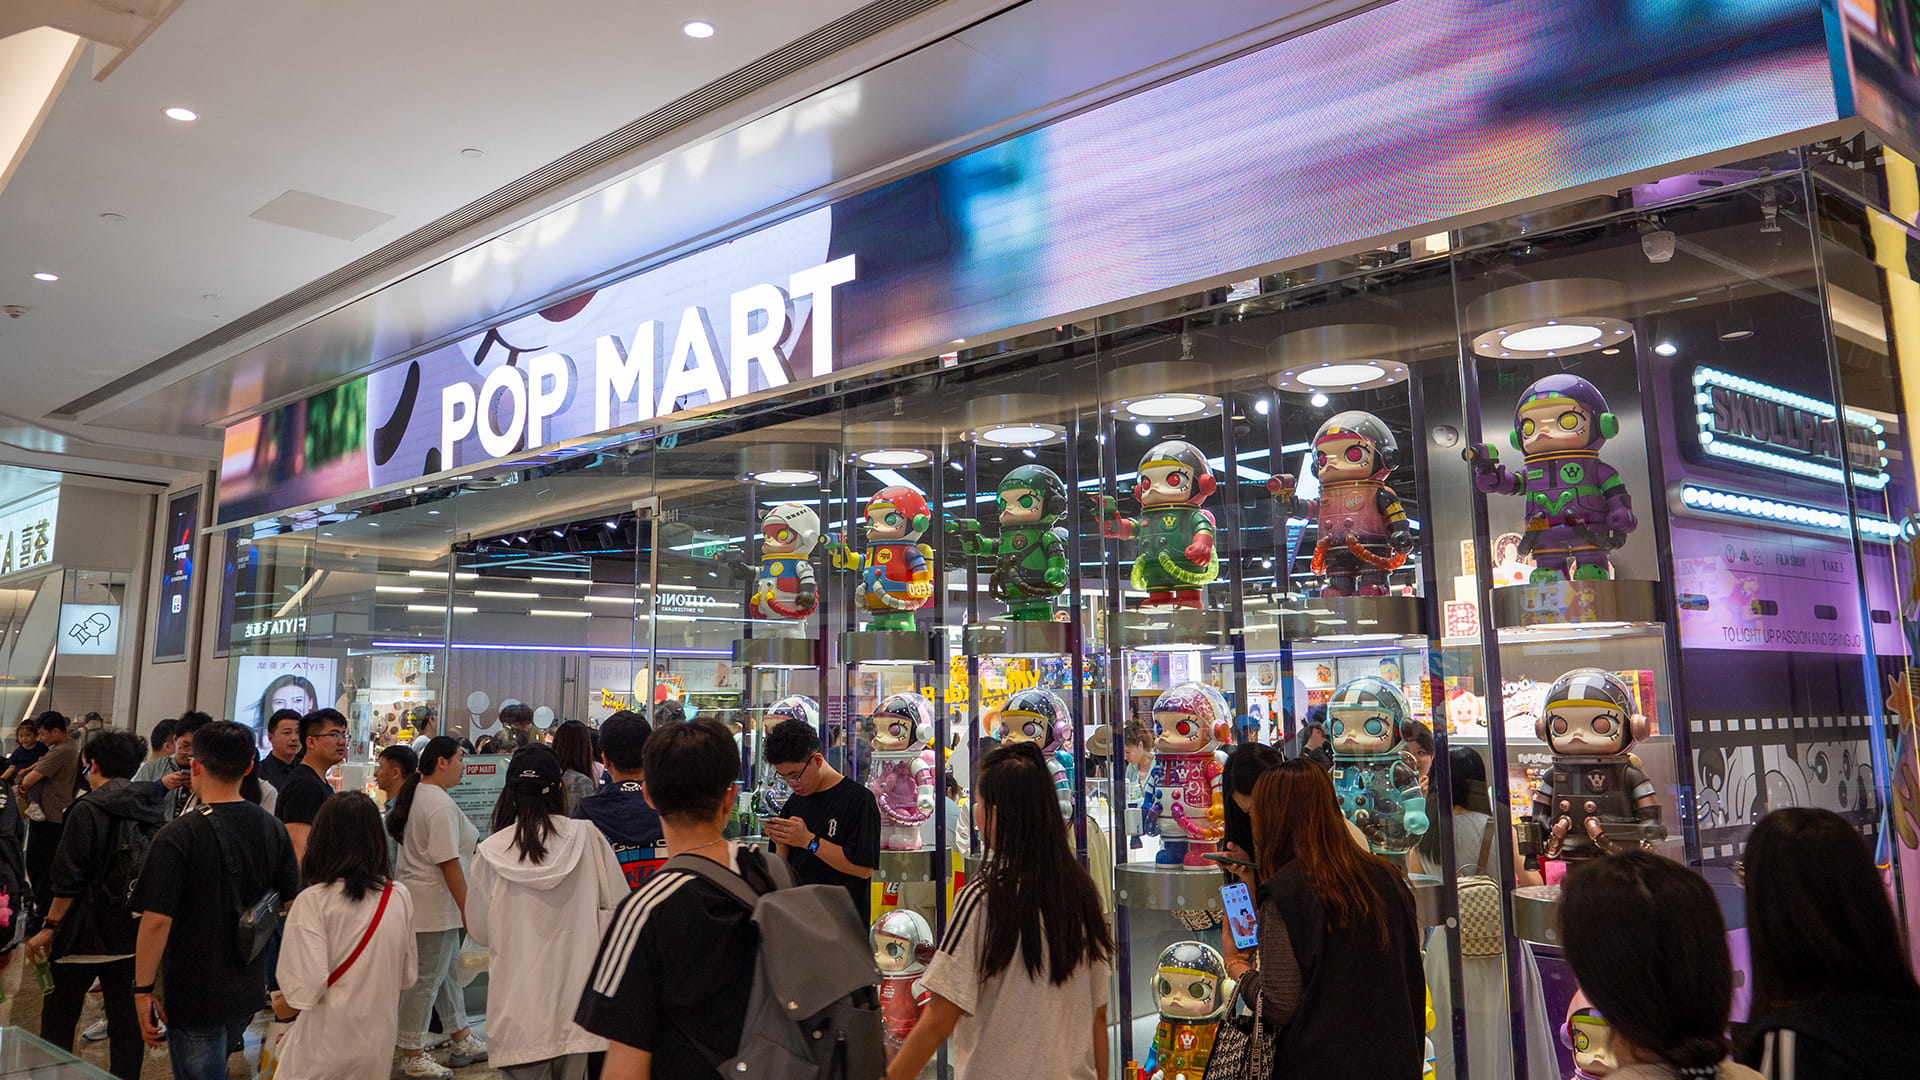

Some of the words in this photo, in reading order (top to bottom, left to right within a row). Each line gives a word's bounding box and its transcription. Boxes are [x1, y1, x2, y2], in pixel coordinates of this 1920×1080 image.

[441, 352, 577, 471] POP
[595, 254, 863, 432] MART
[1763, 629, 1775, 644] UP
